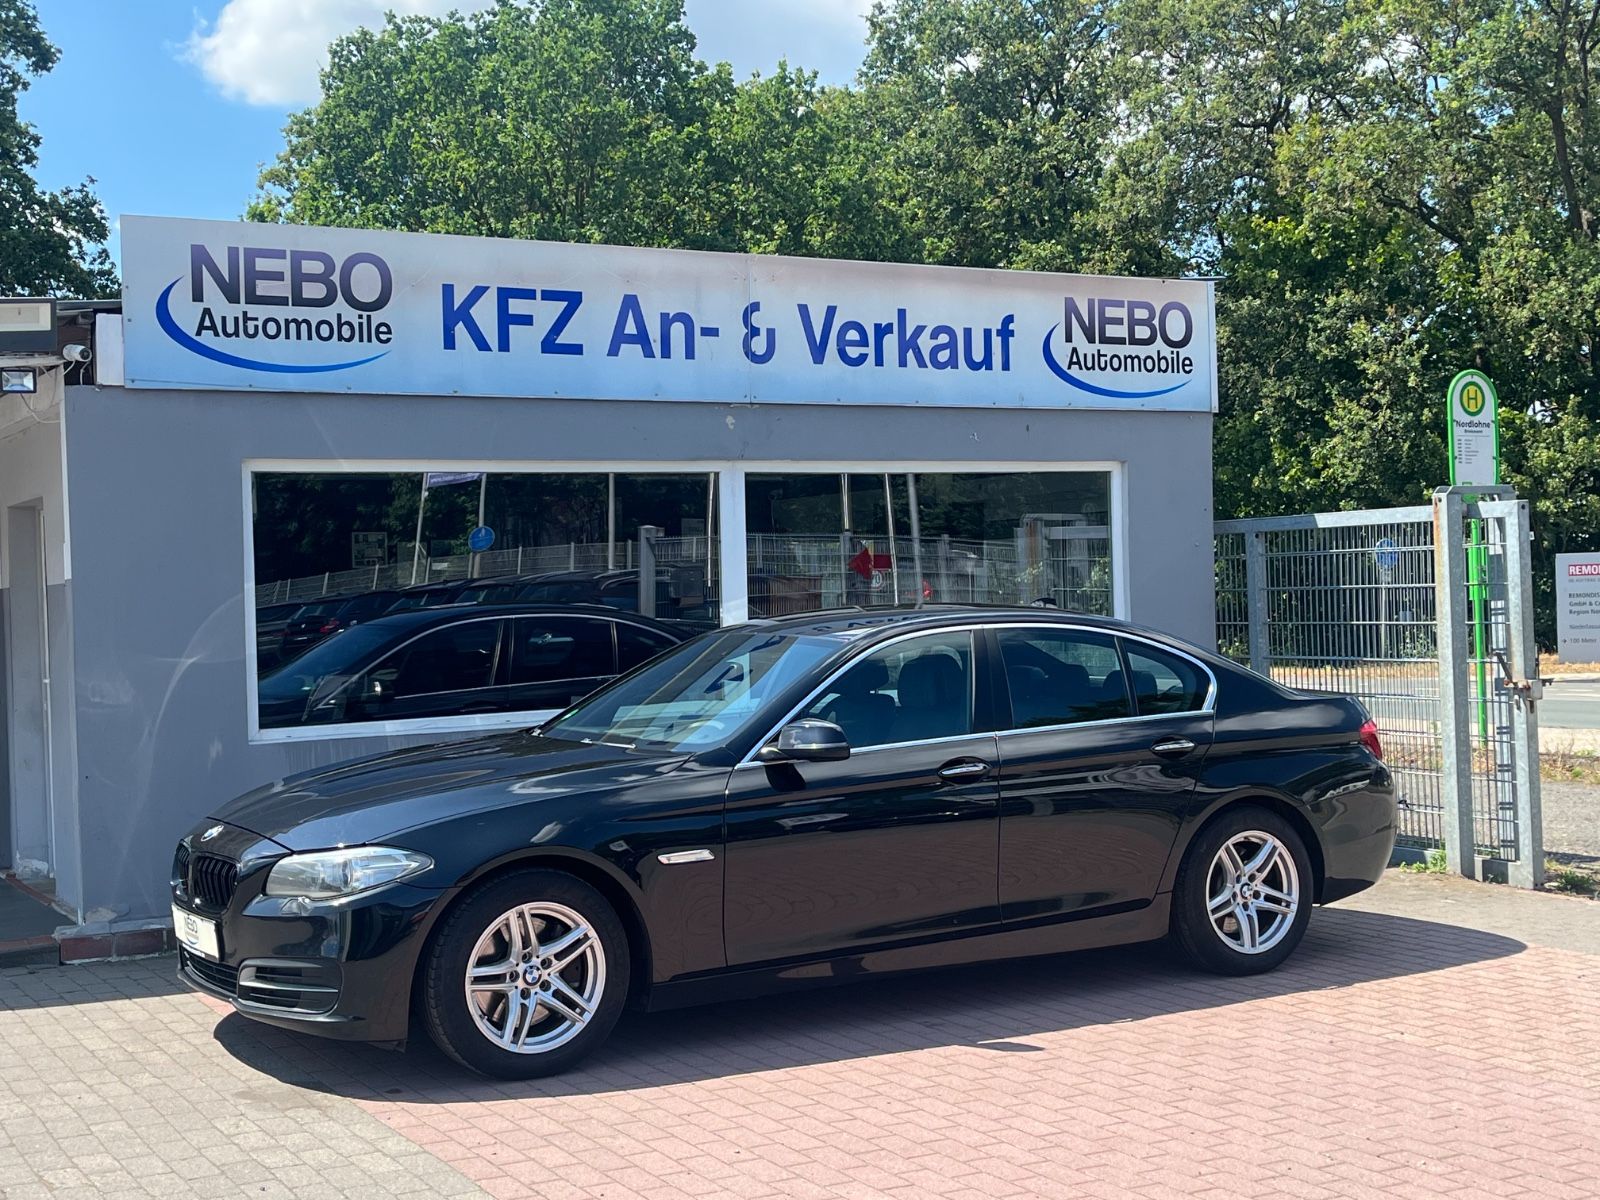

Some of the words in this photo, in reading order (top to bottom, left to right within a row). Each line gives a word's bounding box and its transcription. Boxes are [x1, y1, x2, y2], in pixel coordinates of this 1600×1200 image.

[190, 244, 393, 312] NEBO
[195, 306, 393, 345] Automobile
[442, 284, 584, 356] KFZ
[607, 293, 719, 360] An-
[742, 301, 776, 364] &
[797, 303, 1015, 371] Verkauf
[1063, 297, 1193, 349] NEBO
[1066, 345, 1194, 376] Automobile
[1467, 388, 1478, 409] H
[1455, 419, 1491, 429] Nordlohne
[1569, 564, 1600, 575] REMO
